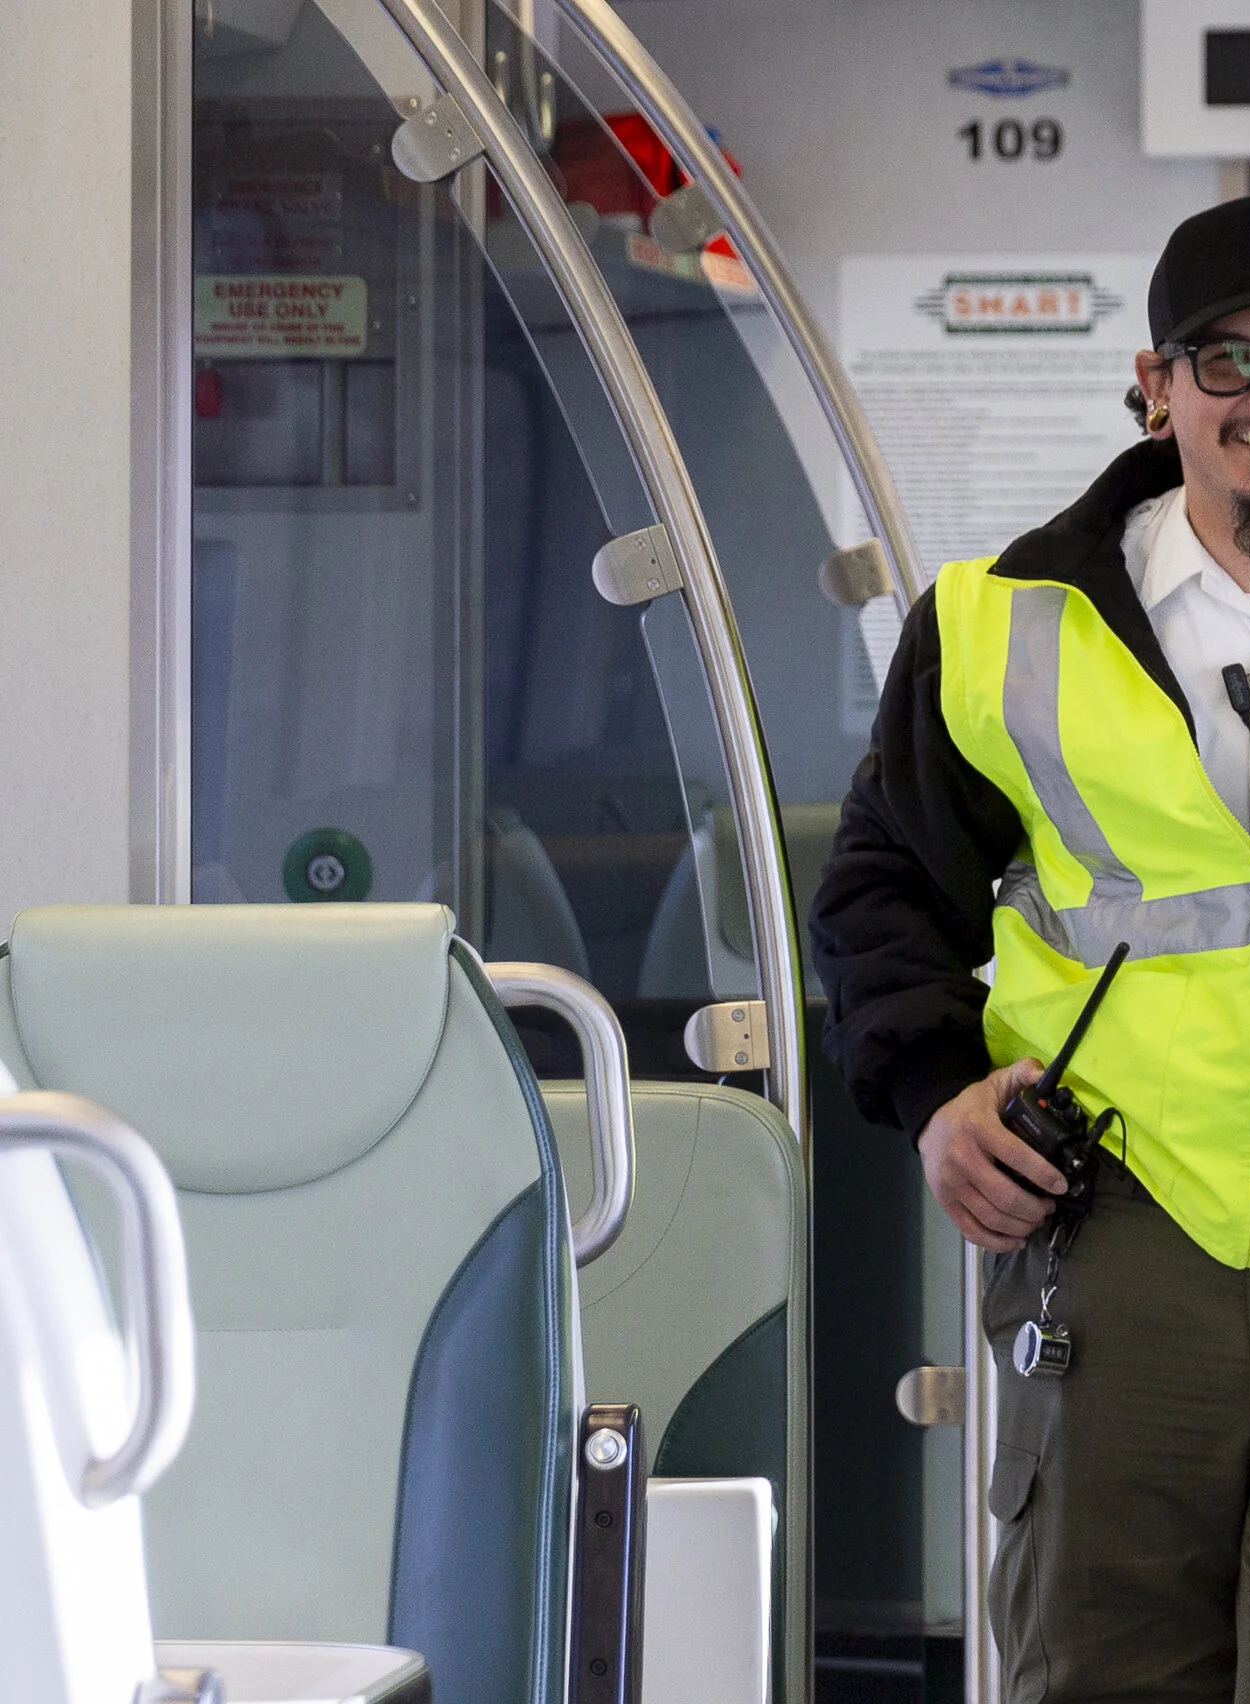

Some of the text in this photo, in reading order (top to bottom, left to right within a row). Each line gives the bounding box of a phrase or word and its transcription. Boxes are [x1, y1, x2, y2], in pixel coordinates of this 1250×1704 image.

[959, 118, 1064, 163] 109
[214, 282, 344, 299] EMERGENCY
[229, 301, 329, 319] USE ONLY
[954, 290, 1081, 316] SMART
